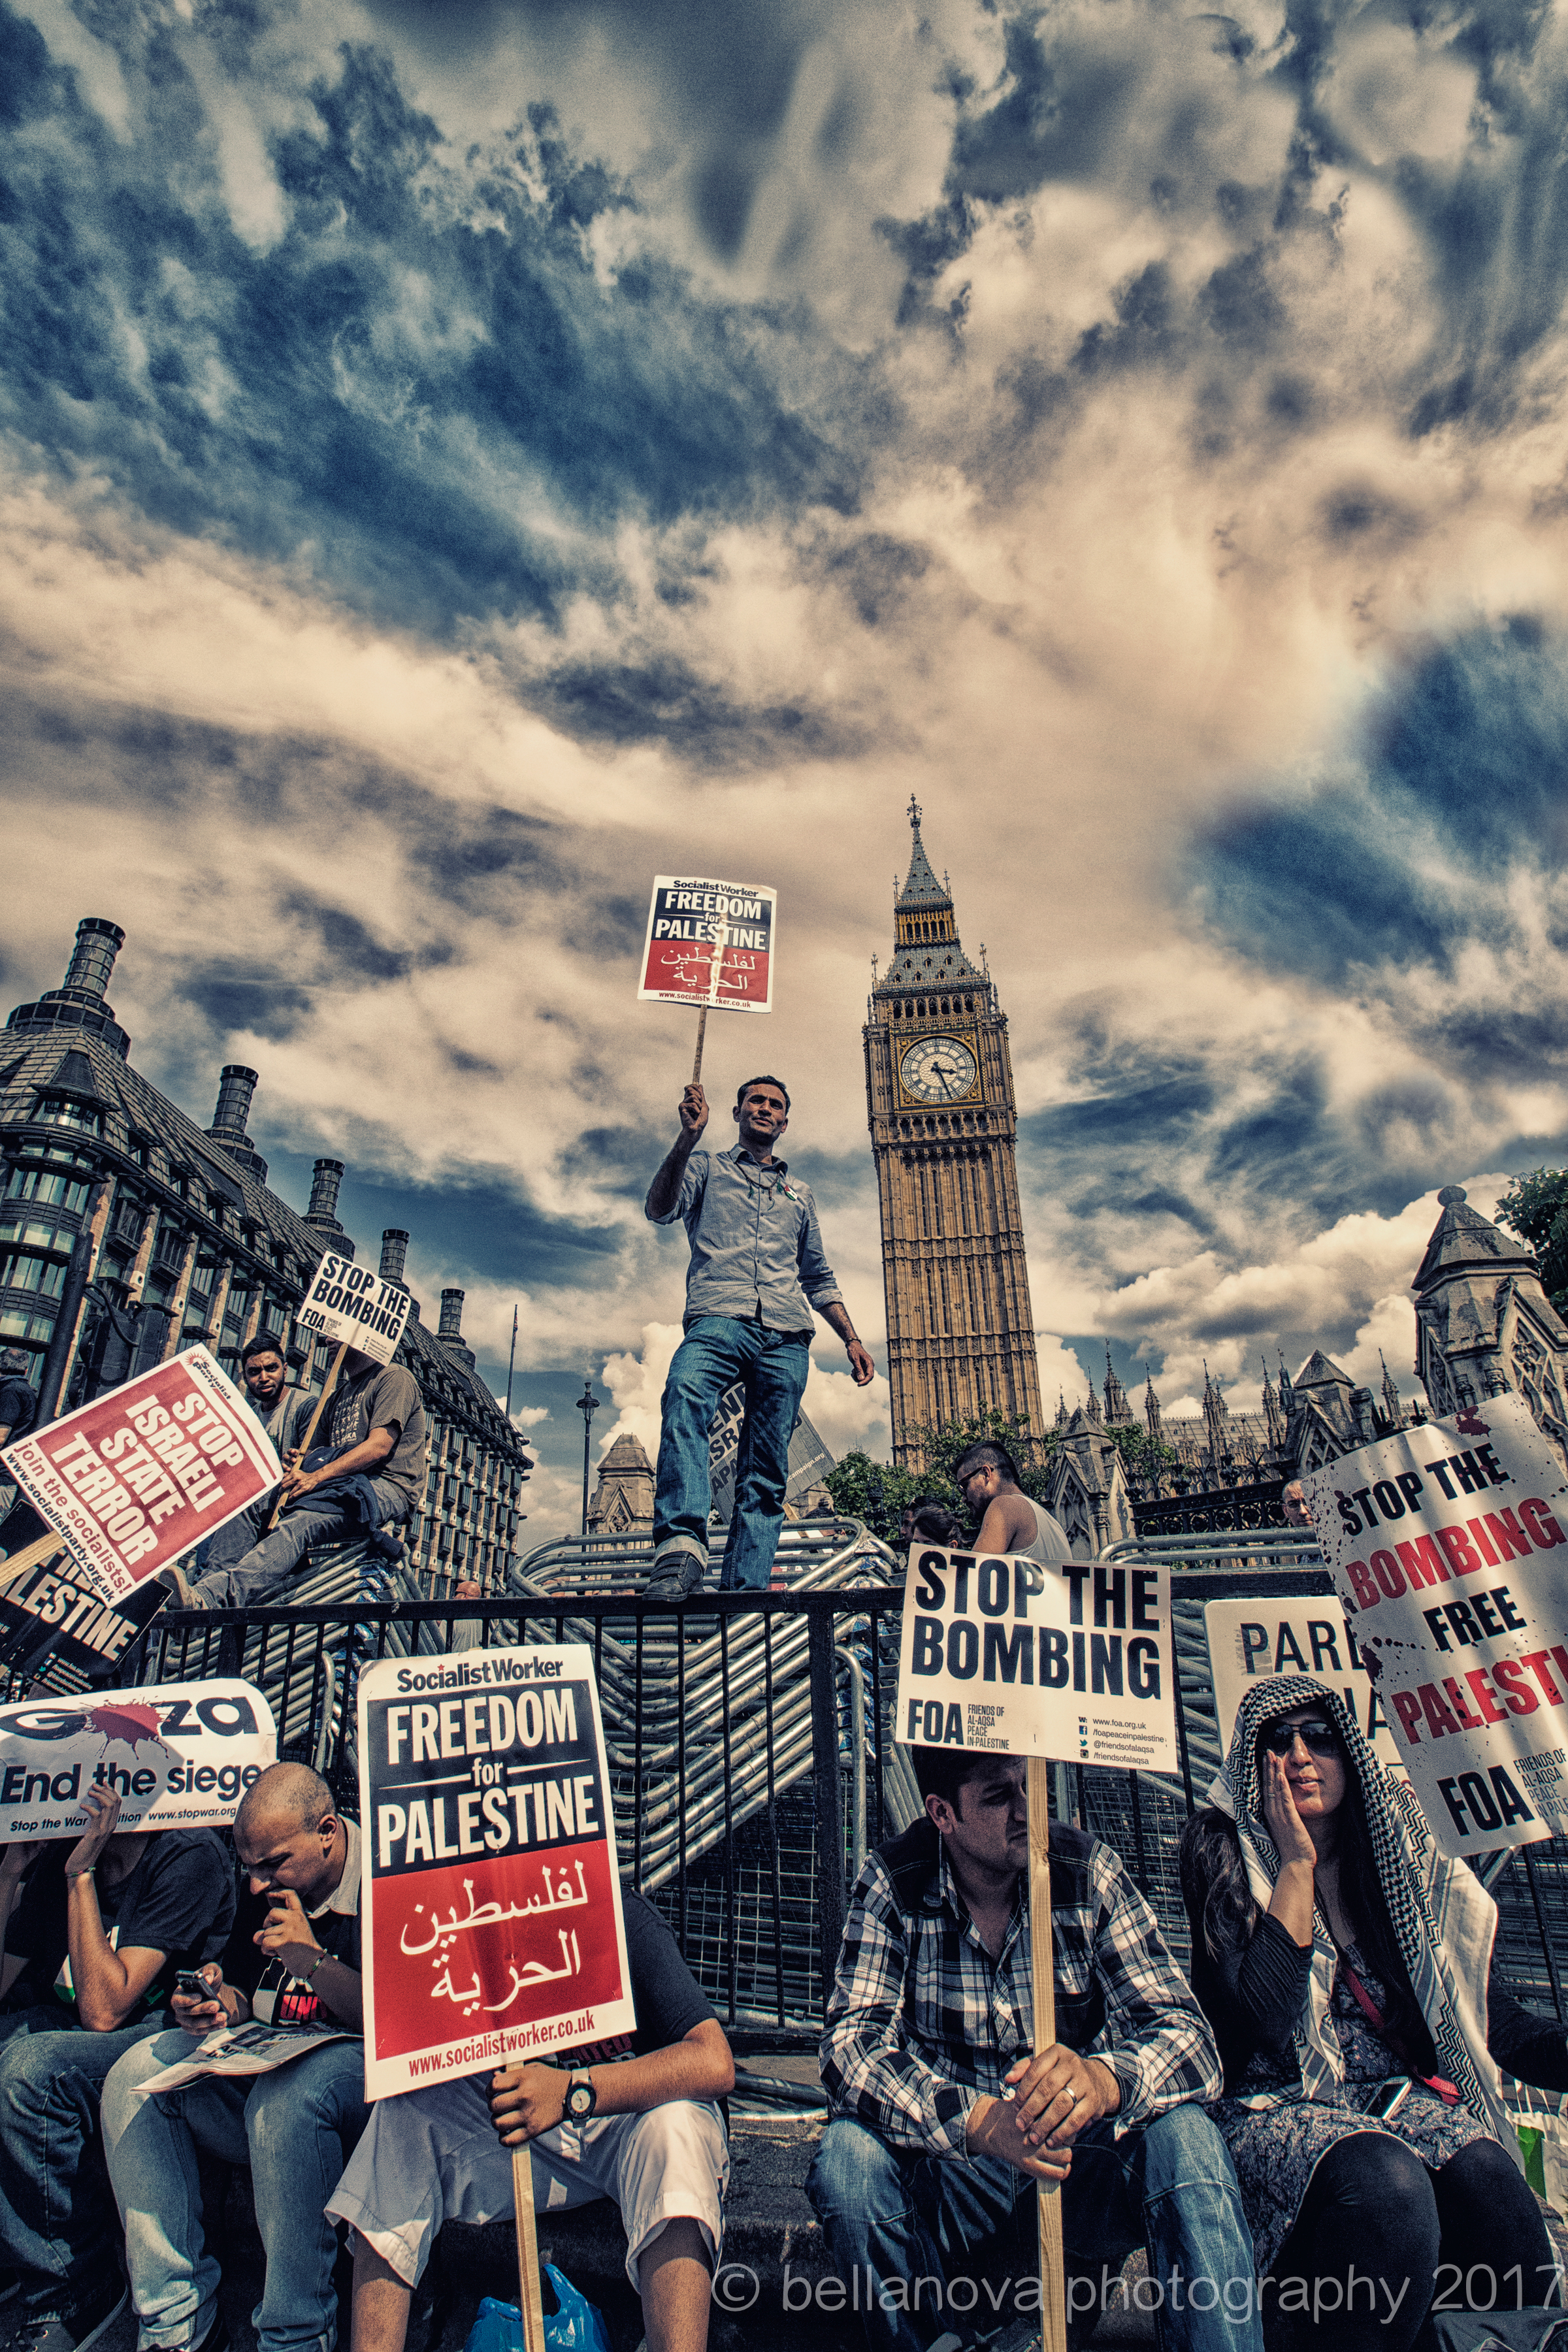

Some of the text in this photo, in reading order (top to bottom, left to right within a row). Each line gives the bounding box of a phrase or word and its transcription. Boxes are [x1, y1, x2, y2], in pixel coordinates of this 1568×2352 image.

[665, 890, 762, 920] FREEDOM
[704, 912, 720, 923] for
[655, 919, 766, 950] PALESTINE
[659, 991, 751, 1008] www.socialistwrker.co.uk
[323, 1255, 409, 1320] STOP THE
[302, 1307, 326, 1331] FOA
[312, 1278, 401, 1342] BOMBING
[192, 1361, 216, 1388] Party
[201, 1362, 231, 1399] Socialist
[125, 1393, 225, 1514] ISRAELI
[173, 1392, 244, 1471] STOP
[50, 1431, 158, 1565] TERROR
[100, 1426, 186, 1526] STATE
[1337, 1443, 1510, 1537] STOP THE
[7, 1453, 115, 1602] www.socialistparty.org.uk
[13, 1442, 46, 1477] join
[43, 1477, 68, 1507] the
[66, 1509, 133, 1594] socialists!
[1345, 1497, 1567, 1611] BOMBING
[915, 1550, 1160, 1631] STOP THE
[1422, 1586, 1527, 1652] FREE
[911, 1615, 1161, 1700] BOMBING
[0, 1696, 259, 1740] Gza
[387, 1688, 578, 1765] FREEDOM
[907, 1698, 964, 1745] FOA
[968, 1704, 1004, 1716] FRIENDS OF
[968, 1714, 995, 1727] AL-AQSA
[968, 1725, 987, 1737] PEACE
[1092, 1718, 1147, 1729] www.foa.org.uk
[1093, 1728, 1164, 1742] /foapeaceinpalestine
[1094, 1740, 1154, 1754] @friendsofalaqsa
[472, 1757, 503, 1787] for
[1094, 1752, 1149, 1765] /friendsofalaqsa
[1513, 1748, 1567, 1774] FRIENDS OF
[1521, 1767, 1564, 1788] AL-AQSA
[0, 1759, 261, 1804] End the siege
[1436, 1765, 1535, 1837] FOA
[1527, 1784, 1560, 1803] PEACE
[10, 1820, 38, 1832] Stop
[42, 1818, 61, 1830] the
[65, 1816, 88, 1827] War
[118, 1812, 142, 1823] ition
[378, 1774, 599, 1868] PALESTINE
[1534, 1803, 1549, 1818] IN
[400, 1859, 588, 1955] لفلسطين
[431, 1929, 582, 2016] الحرية
[408, 2010, 595, 2078] www.socialistworker.co.uk
